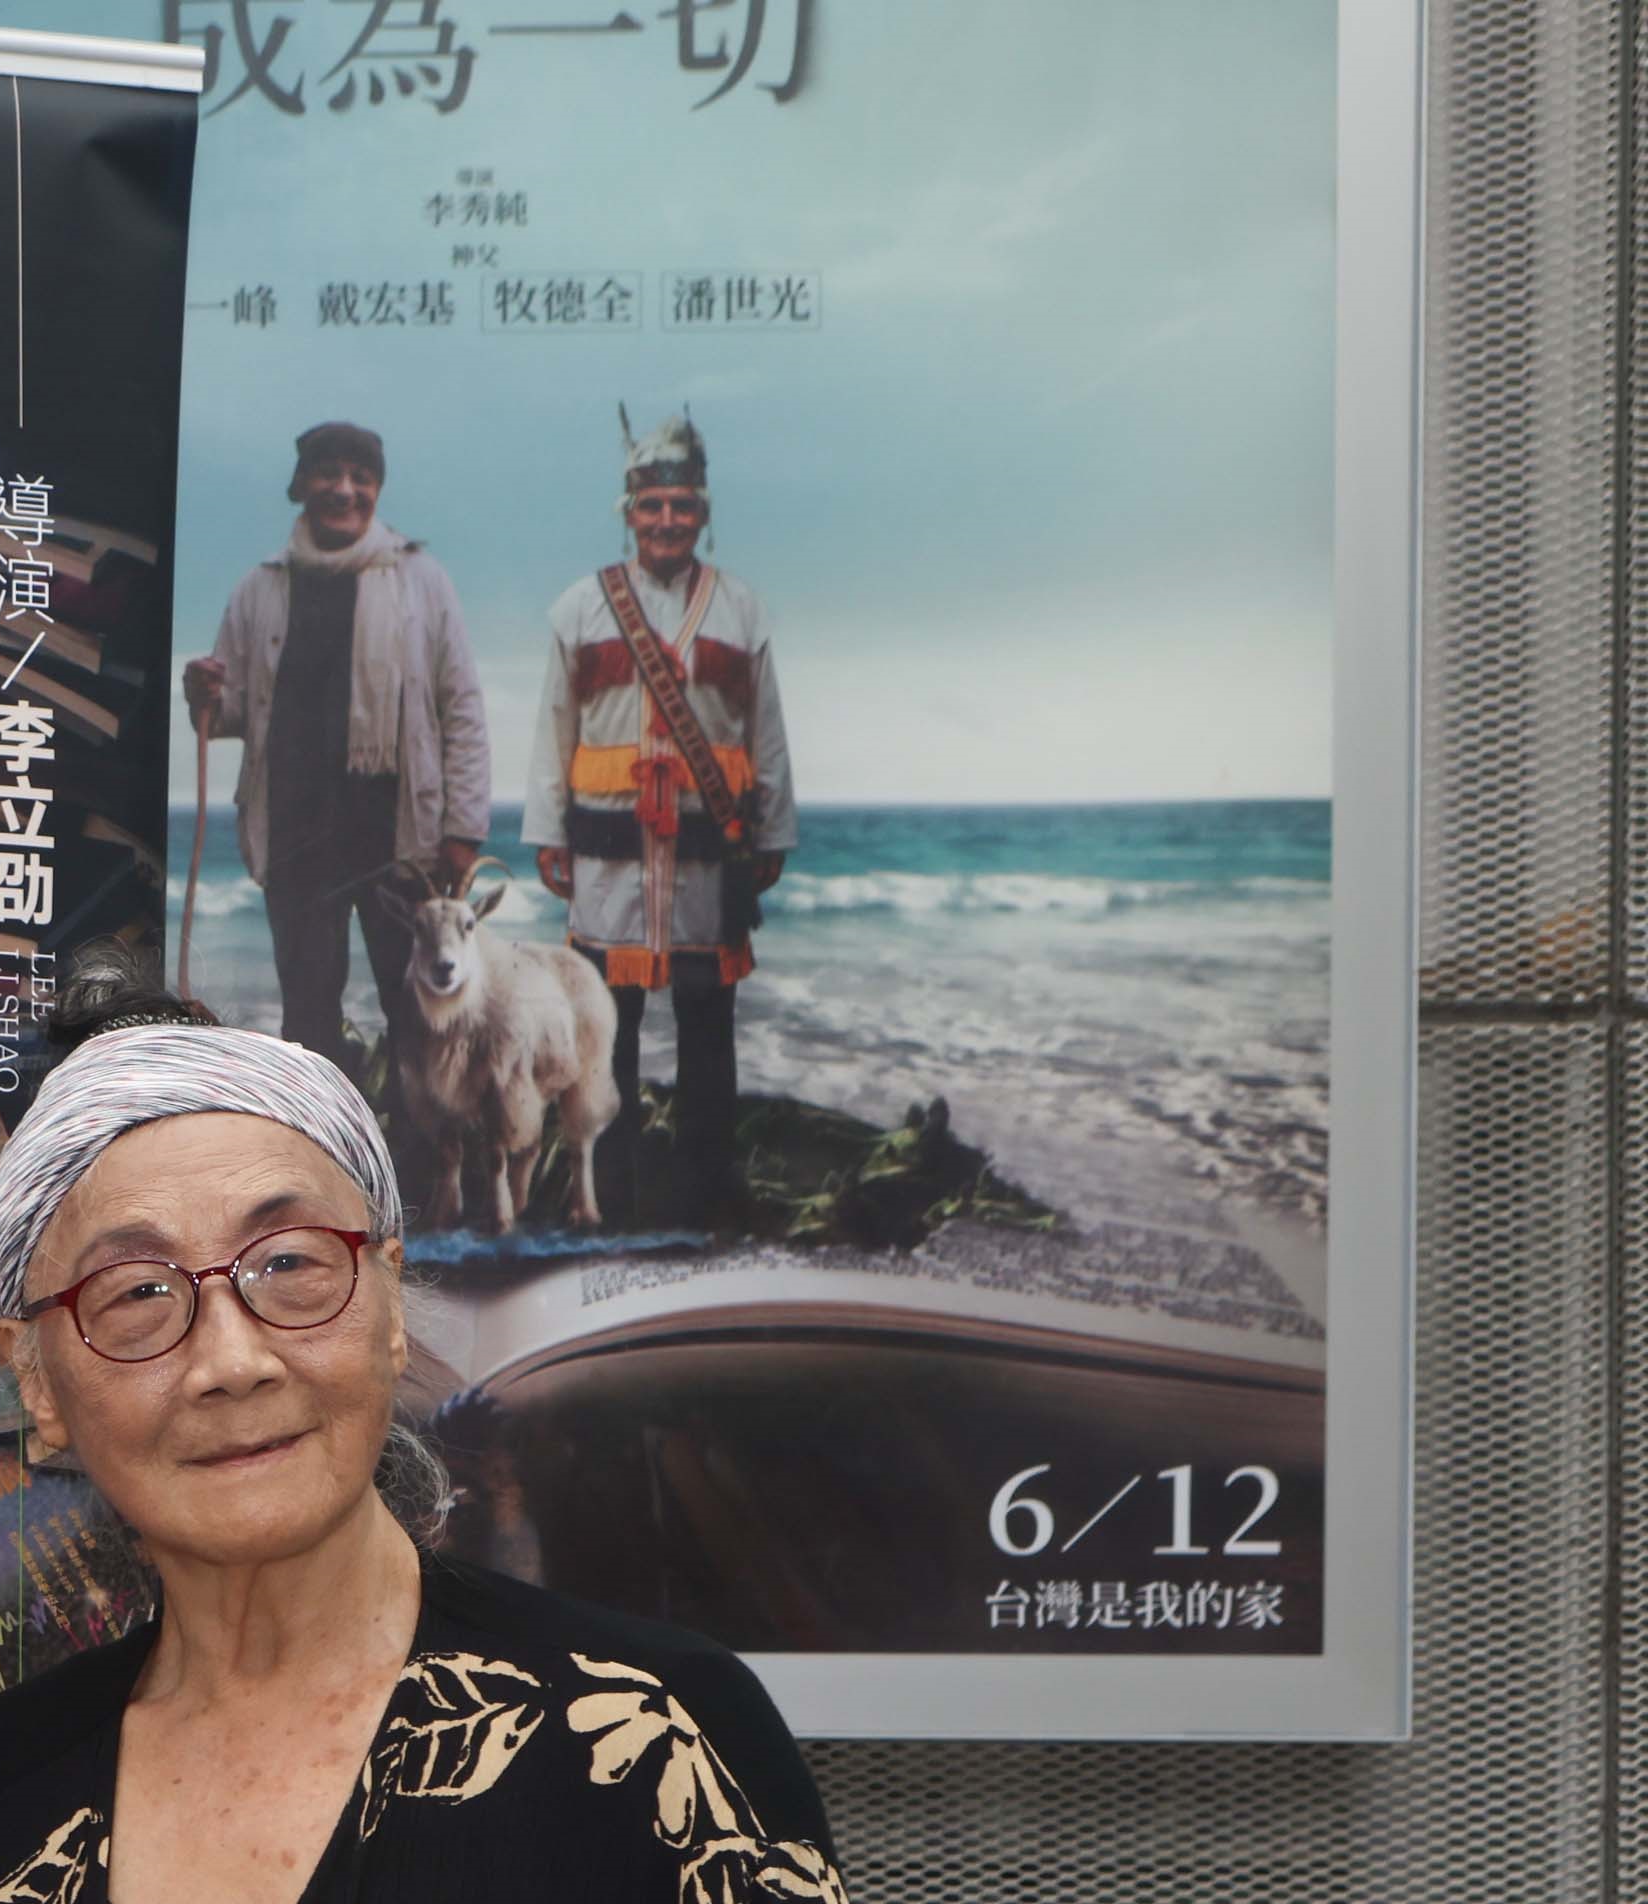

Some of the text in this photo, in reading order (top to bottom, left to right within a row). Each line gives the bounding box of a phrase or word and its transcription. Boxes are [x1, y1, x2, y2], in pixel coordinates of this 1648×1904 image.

[422, 191, 530, 228] 李秀純
[450, 244, 500, 269] 神父
[317, 282, 455, 327] 戴宏基
[494, 280, 633, 326] 牧德全
[671, 278, 812, 323] 潘世光
[31, 950, 56, 1022] LEE
[988, 1463, 1283, 1556] 6/12
[985, 1580, 1284, 1631] 台灣是我的家
